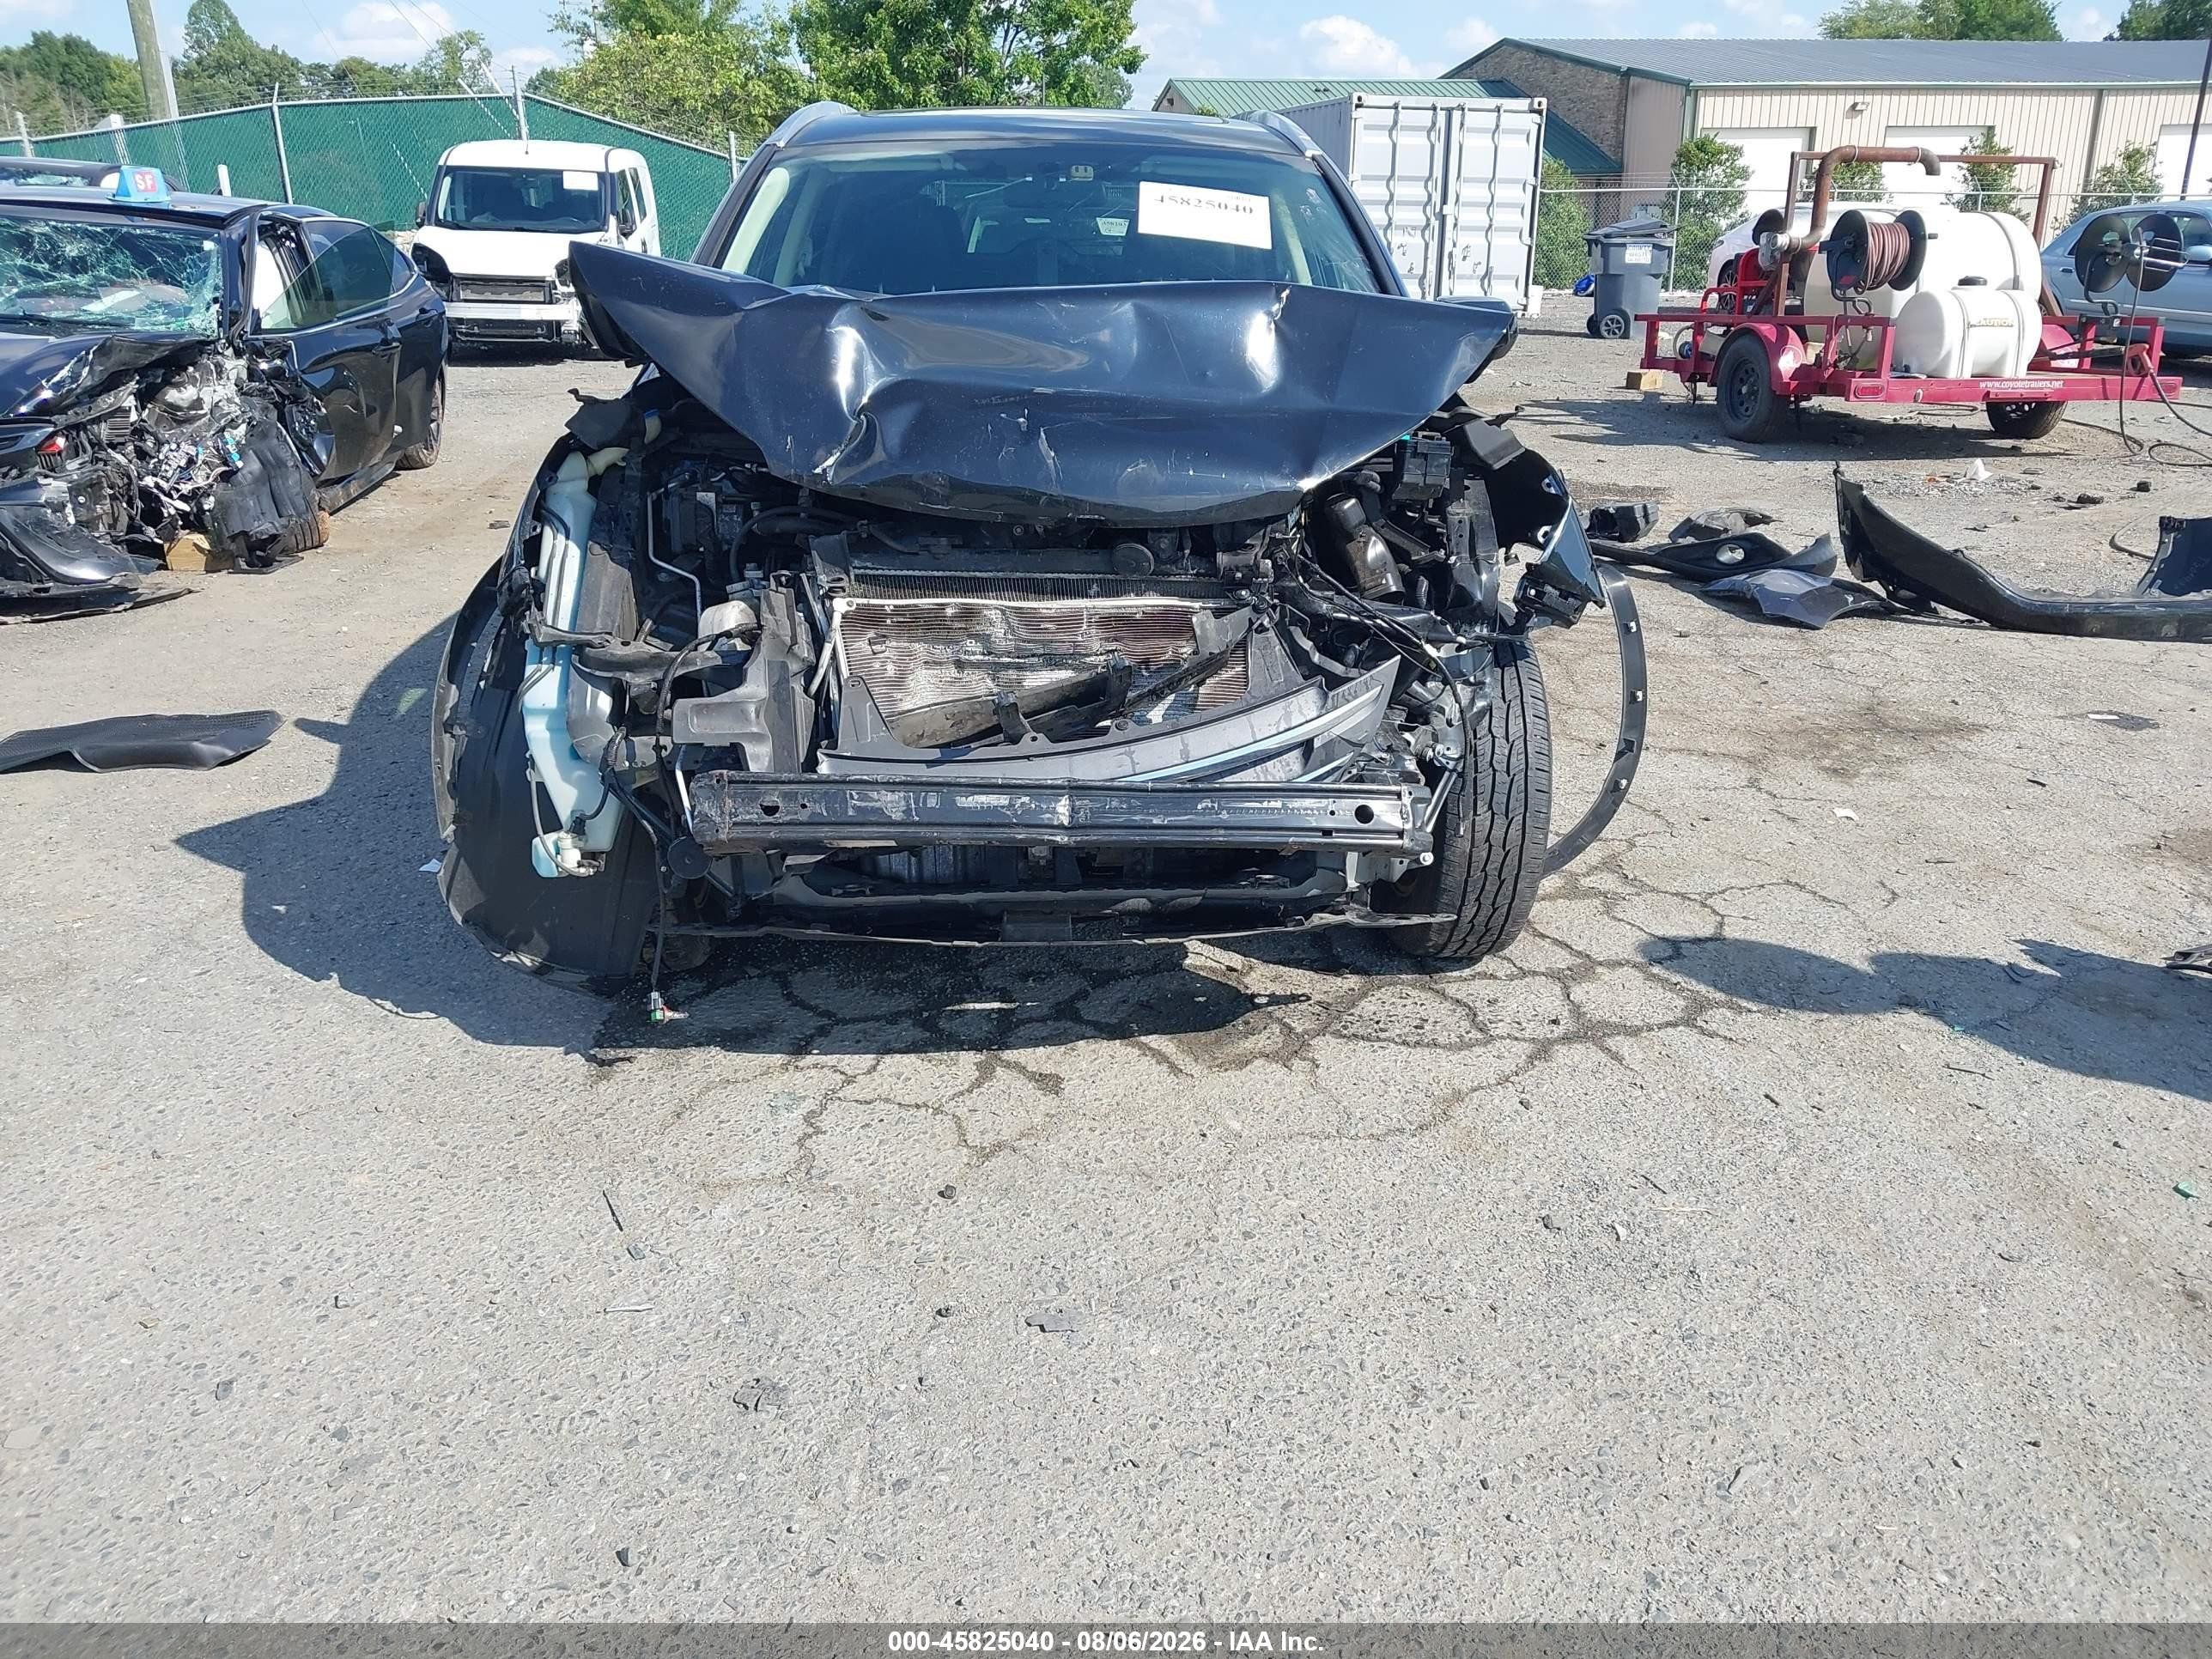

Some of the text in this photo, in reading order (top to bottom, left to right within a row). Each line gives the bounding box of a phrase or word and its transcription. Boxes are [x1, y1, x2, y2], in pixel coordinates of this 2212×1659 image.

[136, 173, 155, 190] SF
[1153, 194, 1254, 214] 45825040
[1979, 380, 2064, 390] www.coyotetrailers.net
